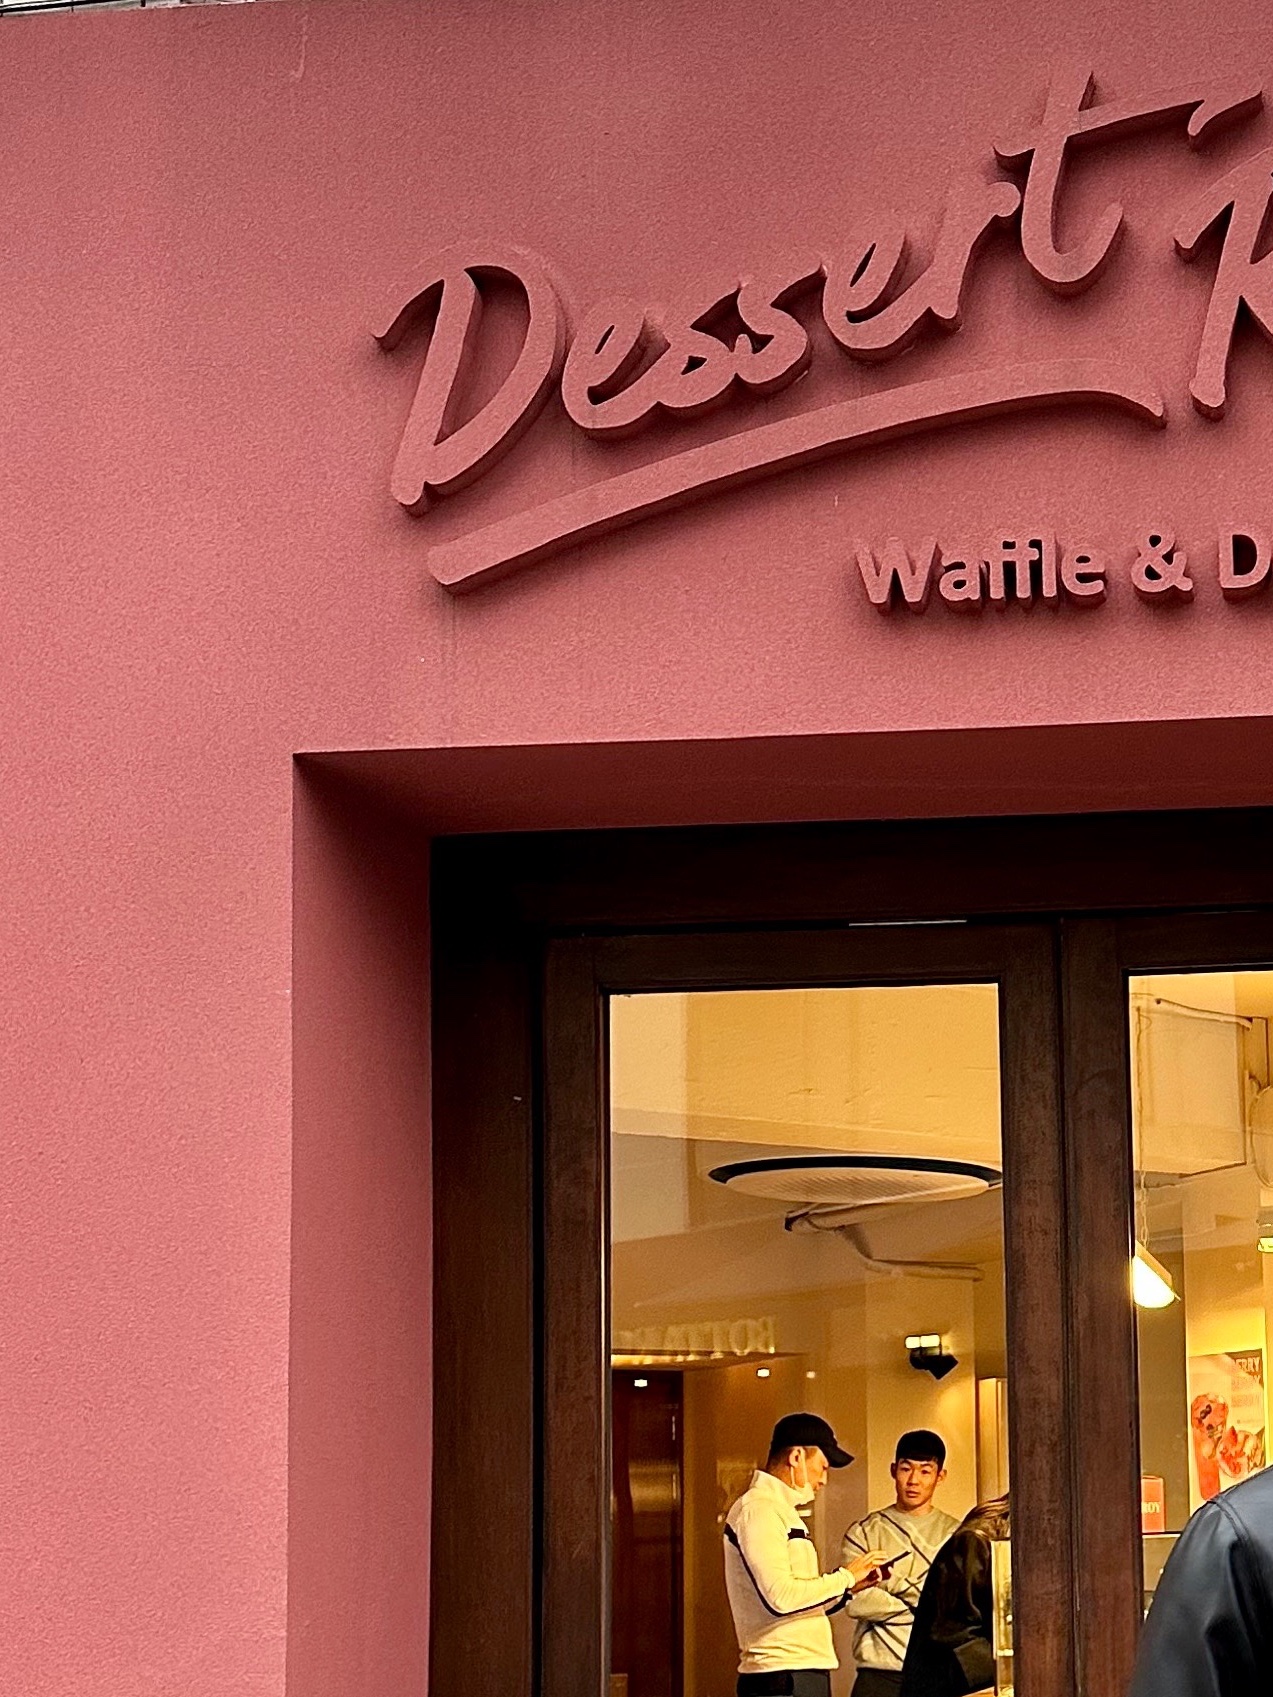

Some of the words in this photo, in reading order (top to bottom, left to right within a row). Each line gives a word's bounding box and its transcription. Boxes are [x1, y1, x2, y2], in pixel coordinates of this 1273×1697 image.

[371, 66, 1264, 514] Dessert
[853, 535, 1106, 612] Waffle
[1130, 524, 1194, 604] &
